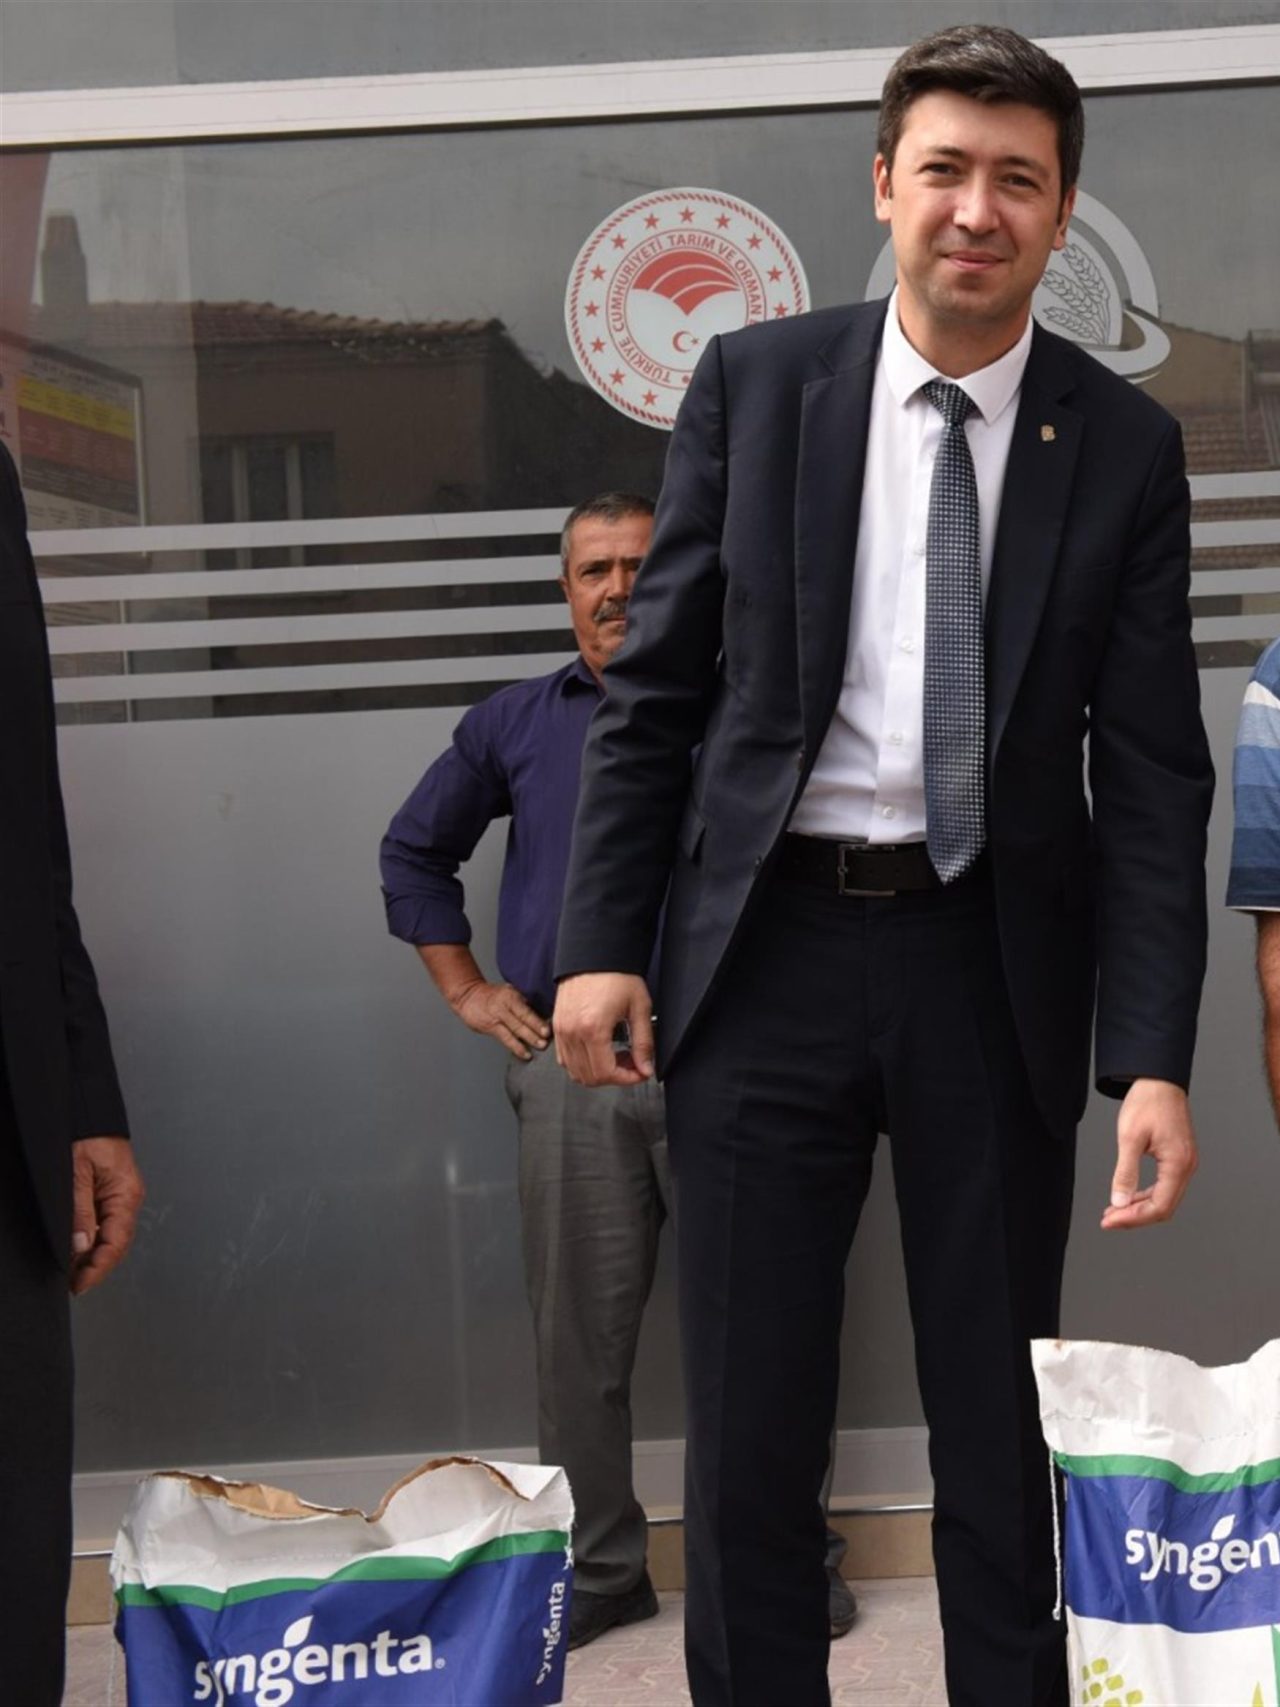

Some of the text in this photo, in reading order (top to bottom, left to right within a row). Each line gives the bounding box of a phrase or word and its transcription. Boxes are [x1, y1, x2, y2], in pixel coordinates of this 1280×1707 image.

[611, 233, 762, 383] TÜRKİYE CUMHURİYETİ TARIM VE ORMAN
[193, 1628, 433, 1707] syngenta
[536, 1581, 565, 1685] syngenta
